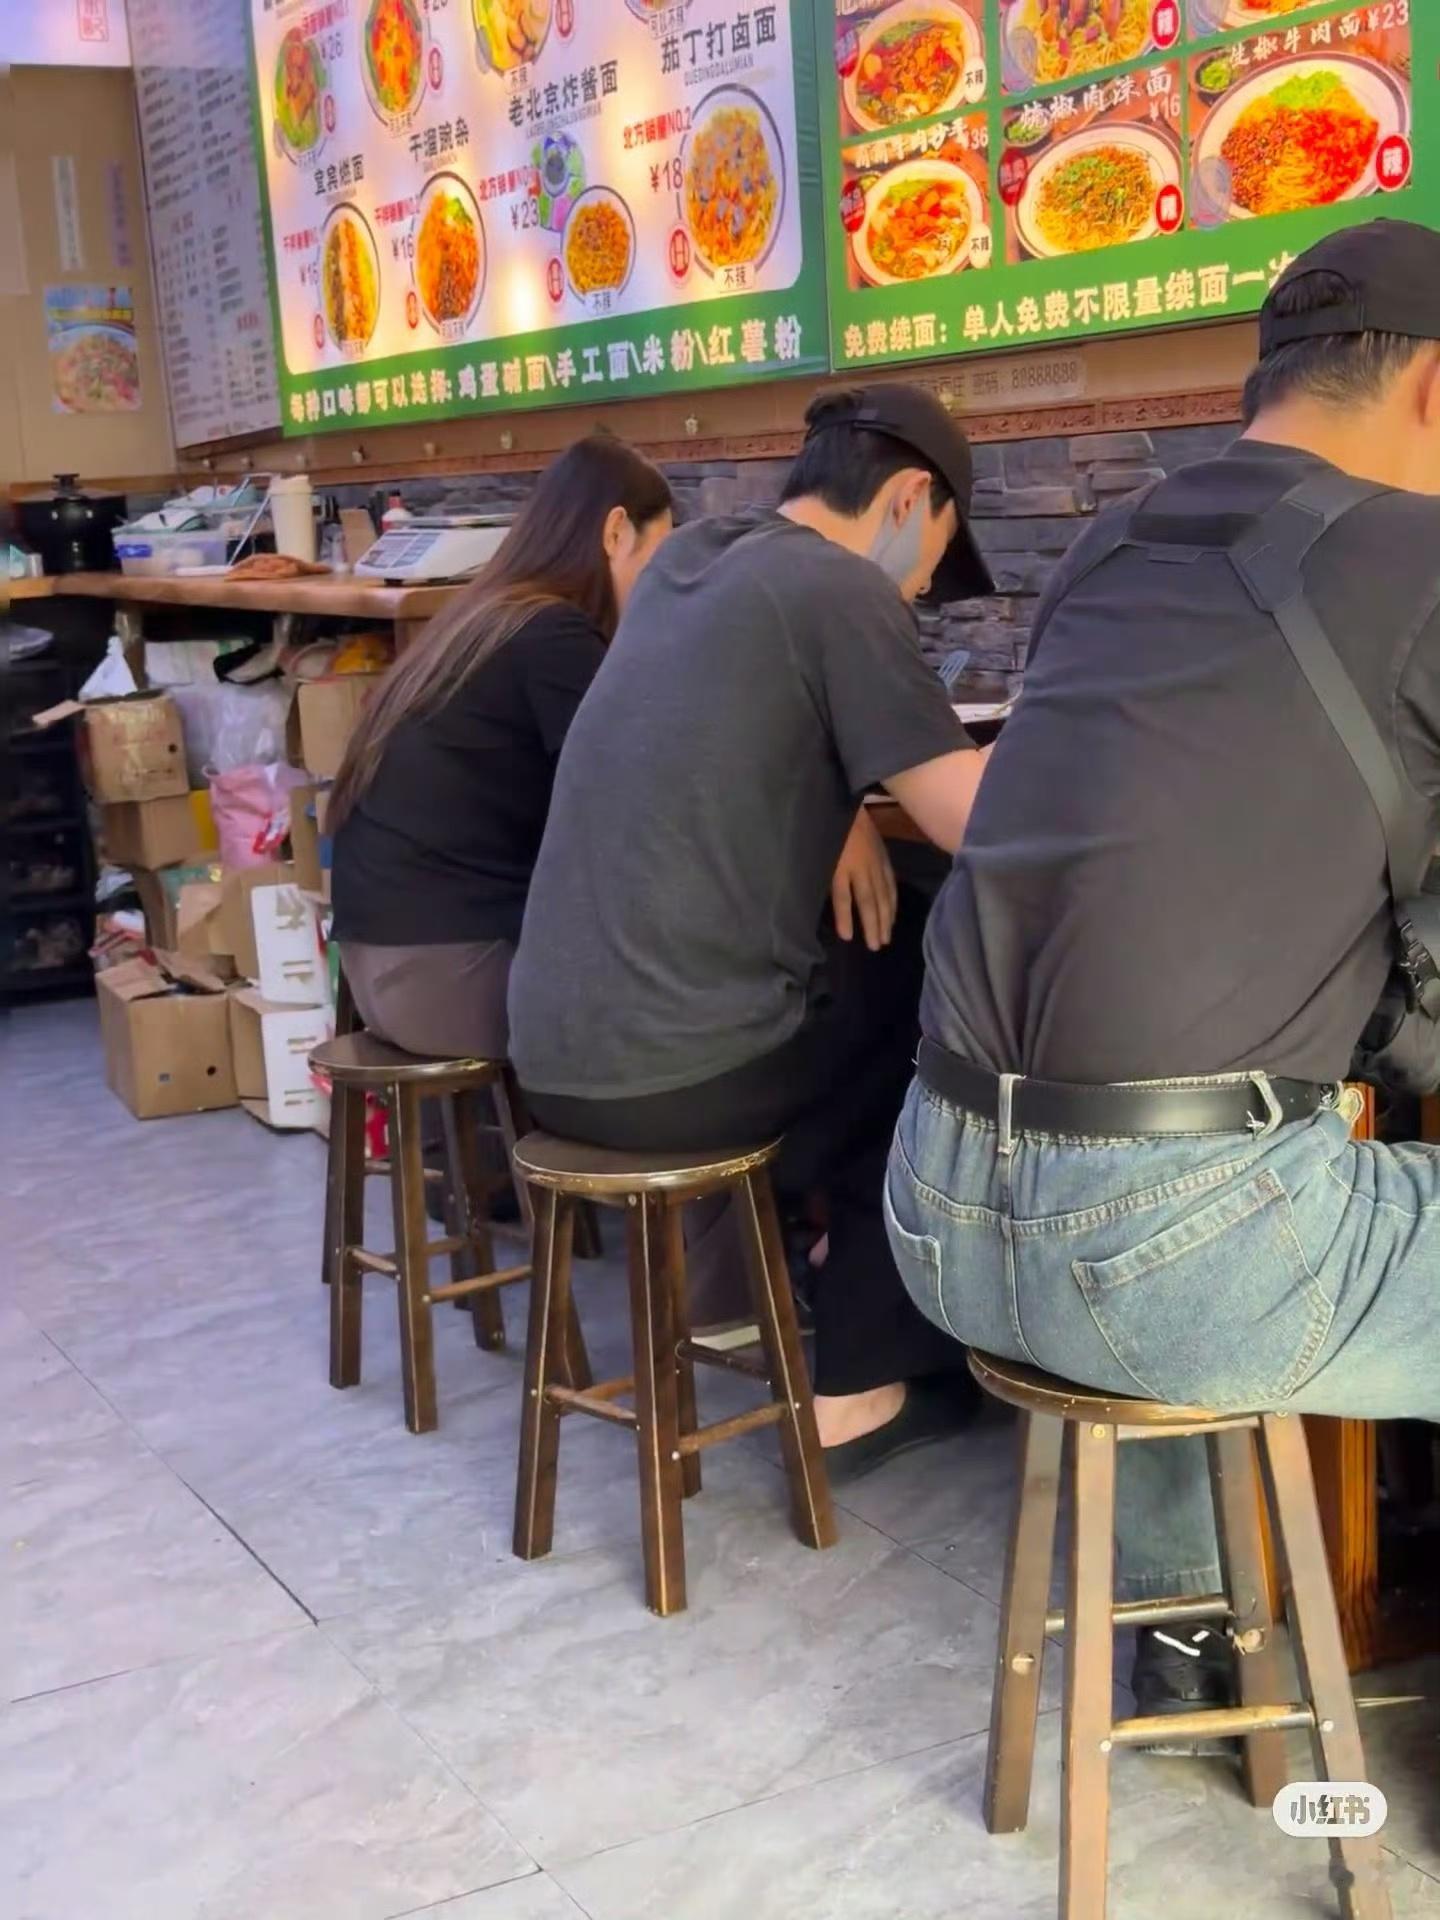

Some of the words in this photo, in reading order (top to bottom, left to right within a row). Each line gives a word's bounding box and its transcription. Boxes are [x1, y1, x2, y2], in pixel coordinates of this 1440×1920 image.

[1368, 0, 1409, 31] ¥23
[661, 5, 776, 75] 茄丁打卤面
[508, 59, 618, 128] 老北京炸酱面
[1150, 93, 1181, 122] ¥16
[649, 157, 684, 193] ¥18
[510, 198, 540, 231] ¥23
